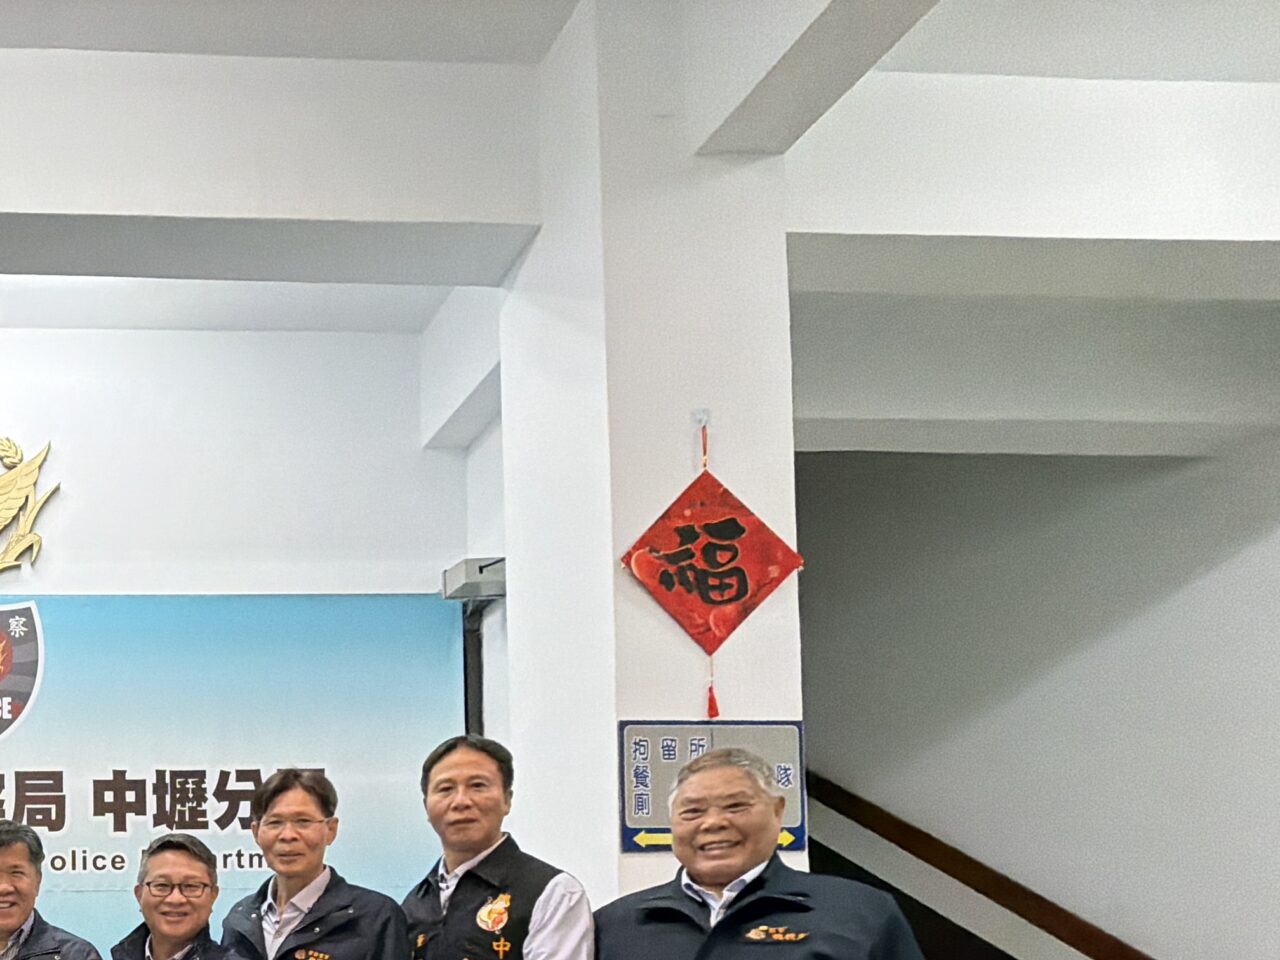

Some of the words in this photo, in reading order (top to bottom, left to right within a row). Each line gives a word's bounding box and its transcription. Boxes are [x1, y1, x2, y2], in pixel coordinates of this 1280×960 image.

[657, 517, 749, 605] 福
[7, 615, 29, 639] 察
[92, 768, 326, 833] 中壢分
[49, 849, 127, 871] olice
